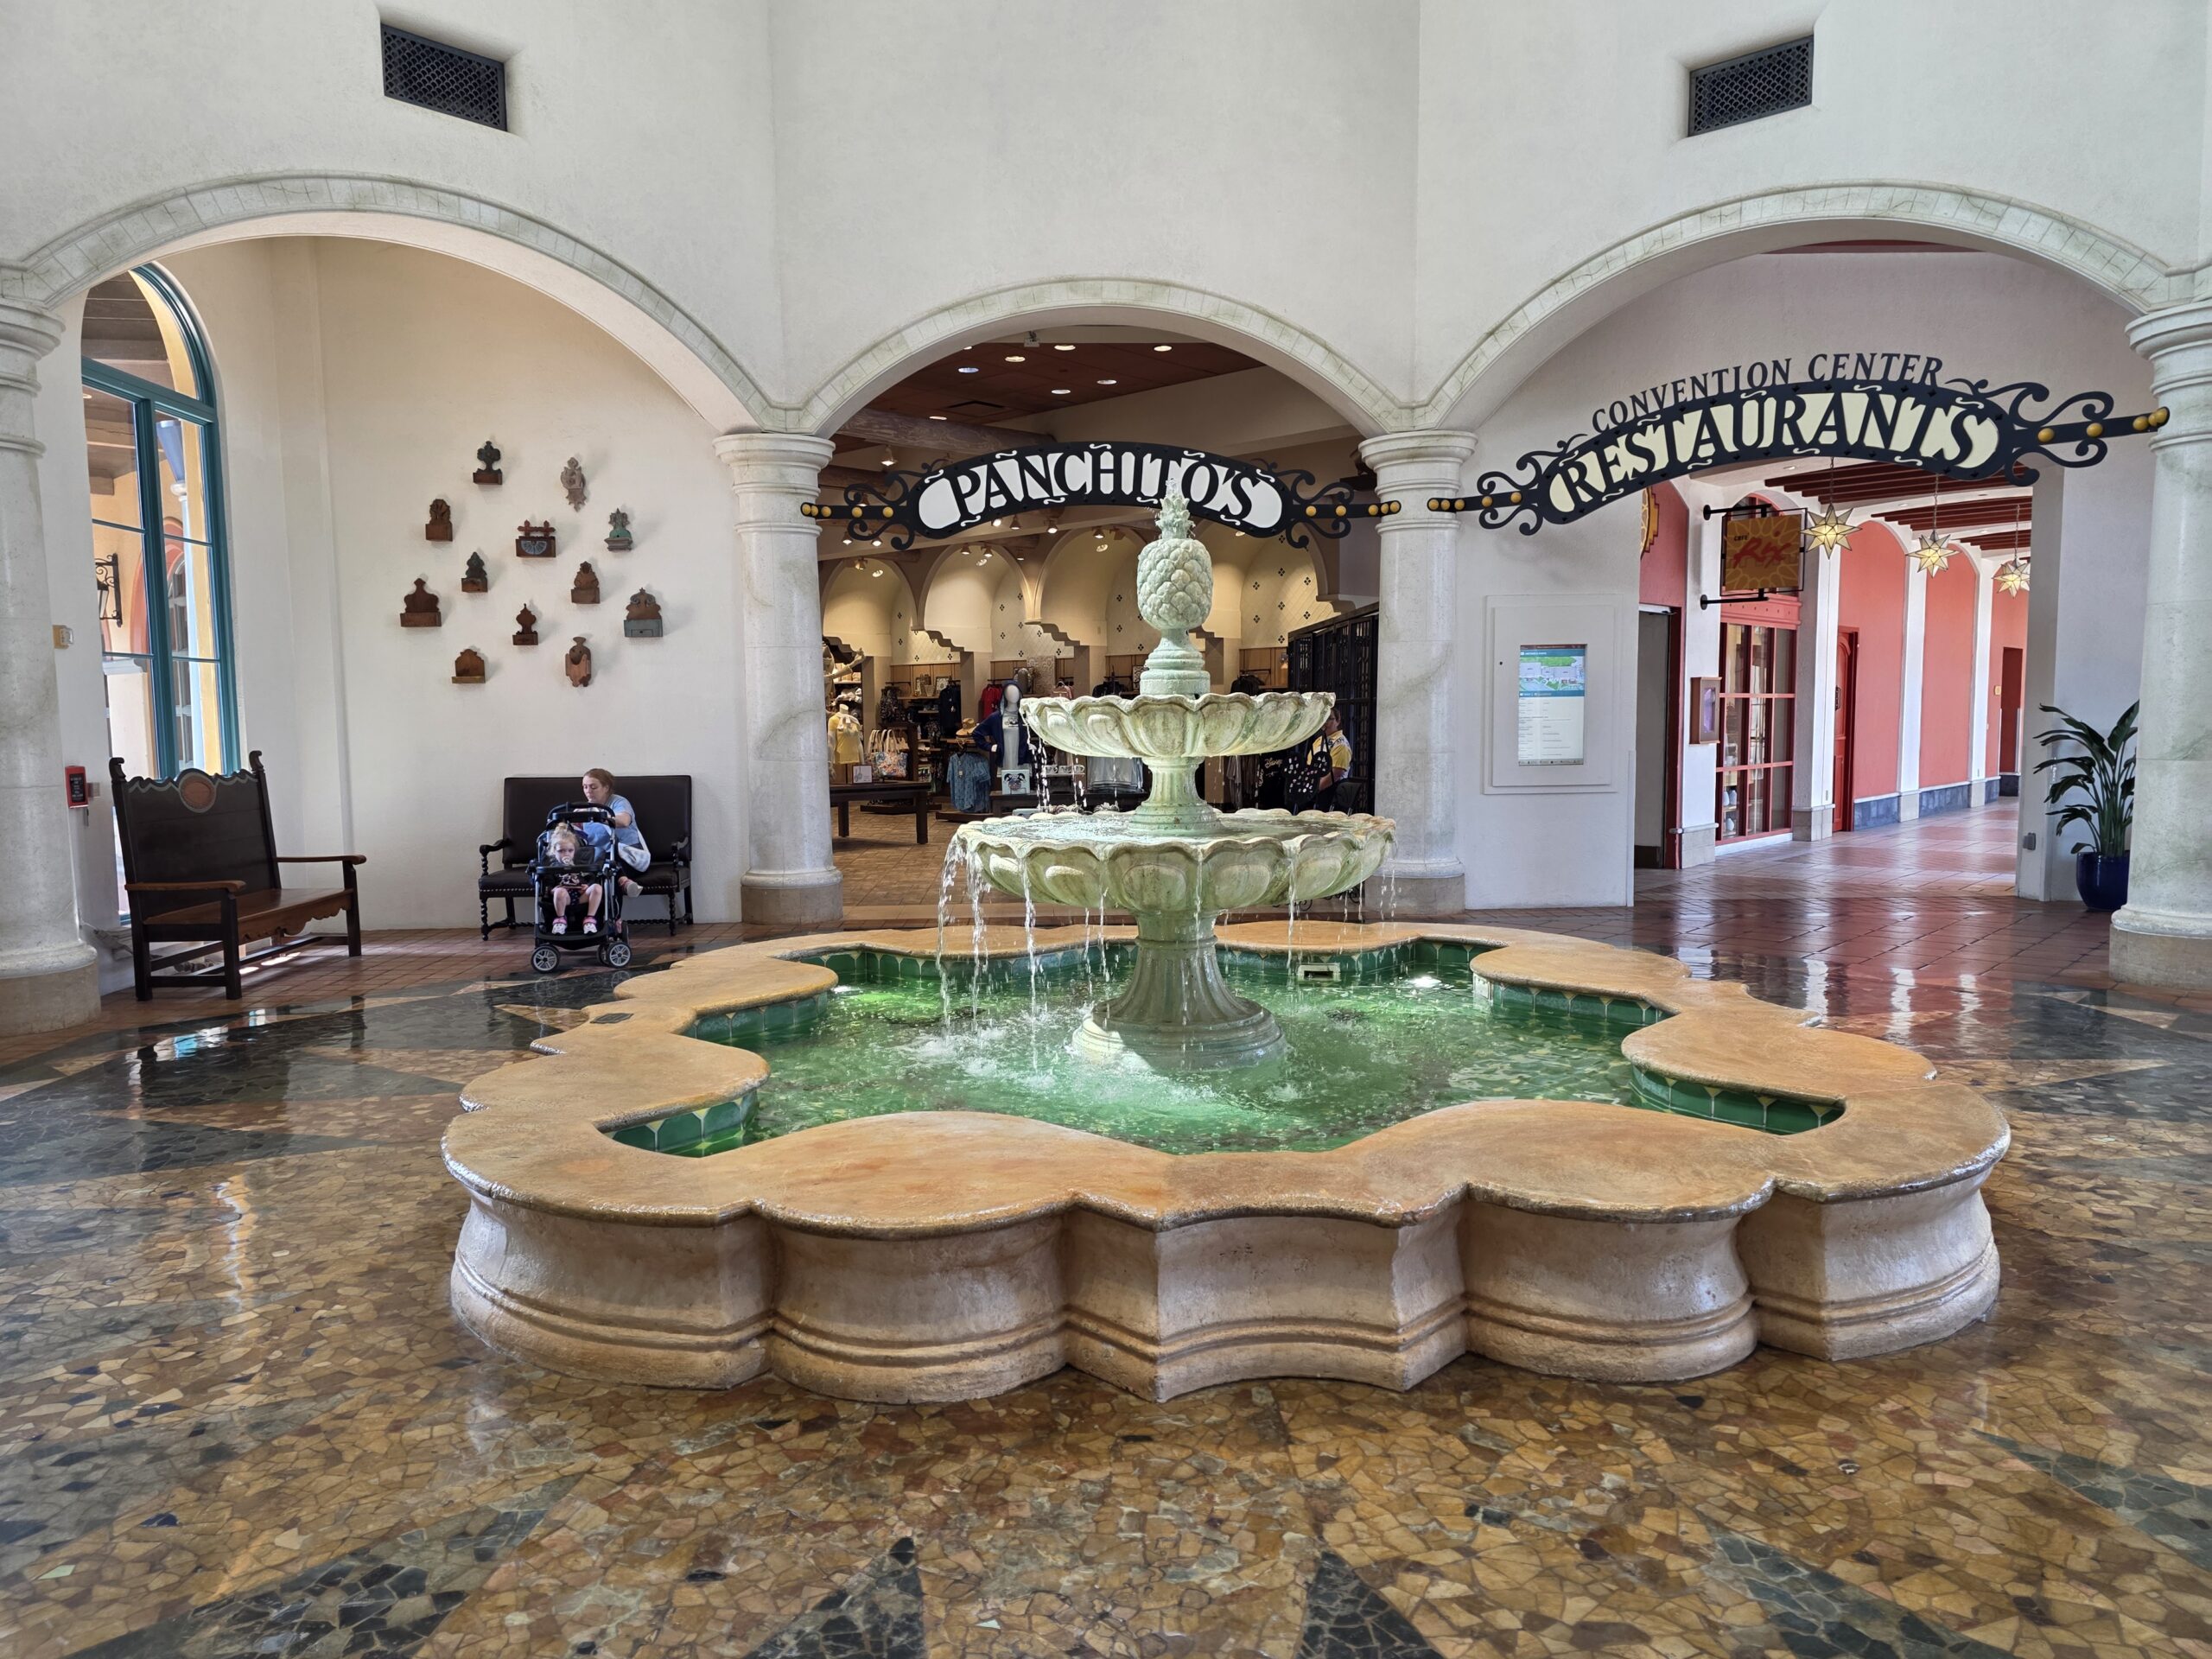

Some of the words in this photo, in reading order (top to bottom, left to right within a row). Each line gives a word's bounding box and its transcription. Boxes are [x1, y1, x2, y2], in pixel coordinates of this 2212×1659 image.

[1592, 358, 1791, 434] CONVENTION
[1808, 353, 1942, 387] CENTER
[952, 449, 1262, 524] PANCHITO'S
[1562, 391, 1989, 508] RESTAURANTS
[1732, 529, 1792, 569] Rix
